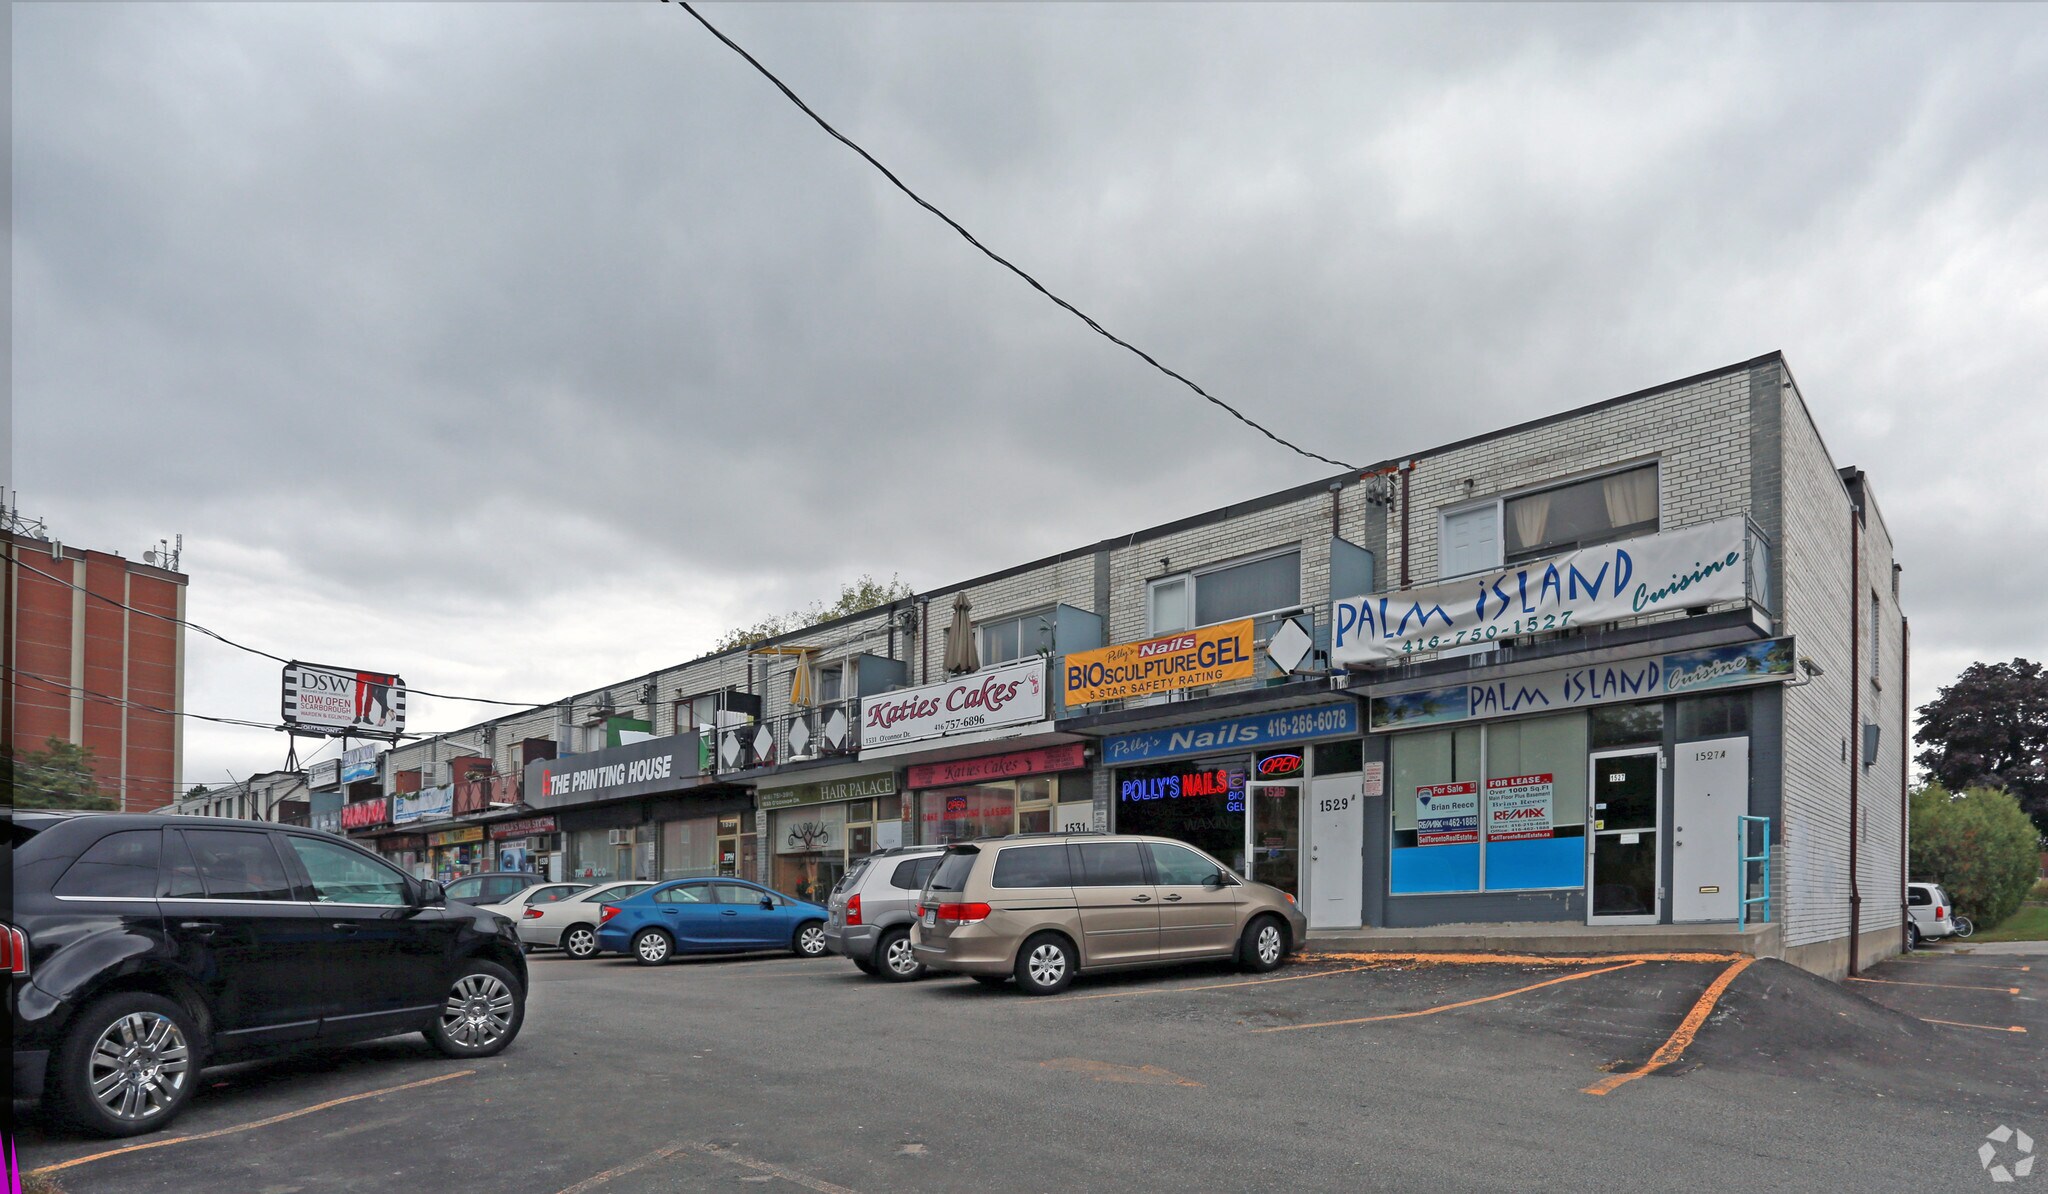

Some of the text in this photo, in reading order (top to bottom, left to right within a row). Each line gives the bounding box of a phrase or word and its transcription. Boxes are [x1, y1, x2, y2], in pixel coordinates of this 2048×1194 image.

[1336, 597, 1454, 647] PALM
[1632, 550, 1739, 613] Cuisine
[1402, 610, 1574, 655] 416-750-1527
[1105, 636, 1195, 663] Polly's Nails
[301, 672, 351, 693] DSW
[1090, 669, 1223, 700] 5 STAR SAFETY RATING
[1471, 682, 1550, 716] PALM
[1667, 656, 1748, 691] Cuisine
[300, 694, 351, 708] NOW OPEN
[300, 702, 351, 714] SCARBOROUGH
[866, 675, 1023, 729] Katies Cakes
[934, 713, 985, 731] 416 757-6896
[866, 735, 877, 744] 1531
[1110, 709, 1347, 758] Polly's Nails 416-266-6078
[944, 764, 980, 781] Katies
[983, 759, 1018, 775] Cakes
[1262, 756, 1302, 775] OPEN
[550, 755, 673, 796] THE PRINTING HOUSE
[1511, 776, 1540, 785] LEASE
[1610, 774, 1625, 782] 1527
[821, 778, 892, 801] HAIR PALACE
[1122, 769, 1228, 802] POLLY'S NAILS
[1263, 787, 1286, 798] 1529
[1433, 786, 1445, 795] For
[1446, 784, 1463, 793] Sale
[1228, 790, 1245, 801] BIO
[947, 800, 967, 810] OPEN
[1226, 801, 1245, 812] GEL
[1320, 798, 1348, 812] 1529
[1431, 803, 1450, 811] Brian
[1493, 807, 1545, 820] RE/MAX
[1064, 822, 1086, 832] 1531
[1418, 819, 1443, 829] RE/MAX
[1448, 816, 1477, 827] 462-1888
[724, 852, 735, 861] TPH
